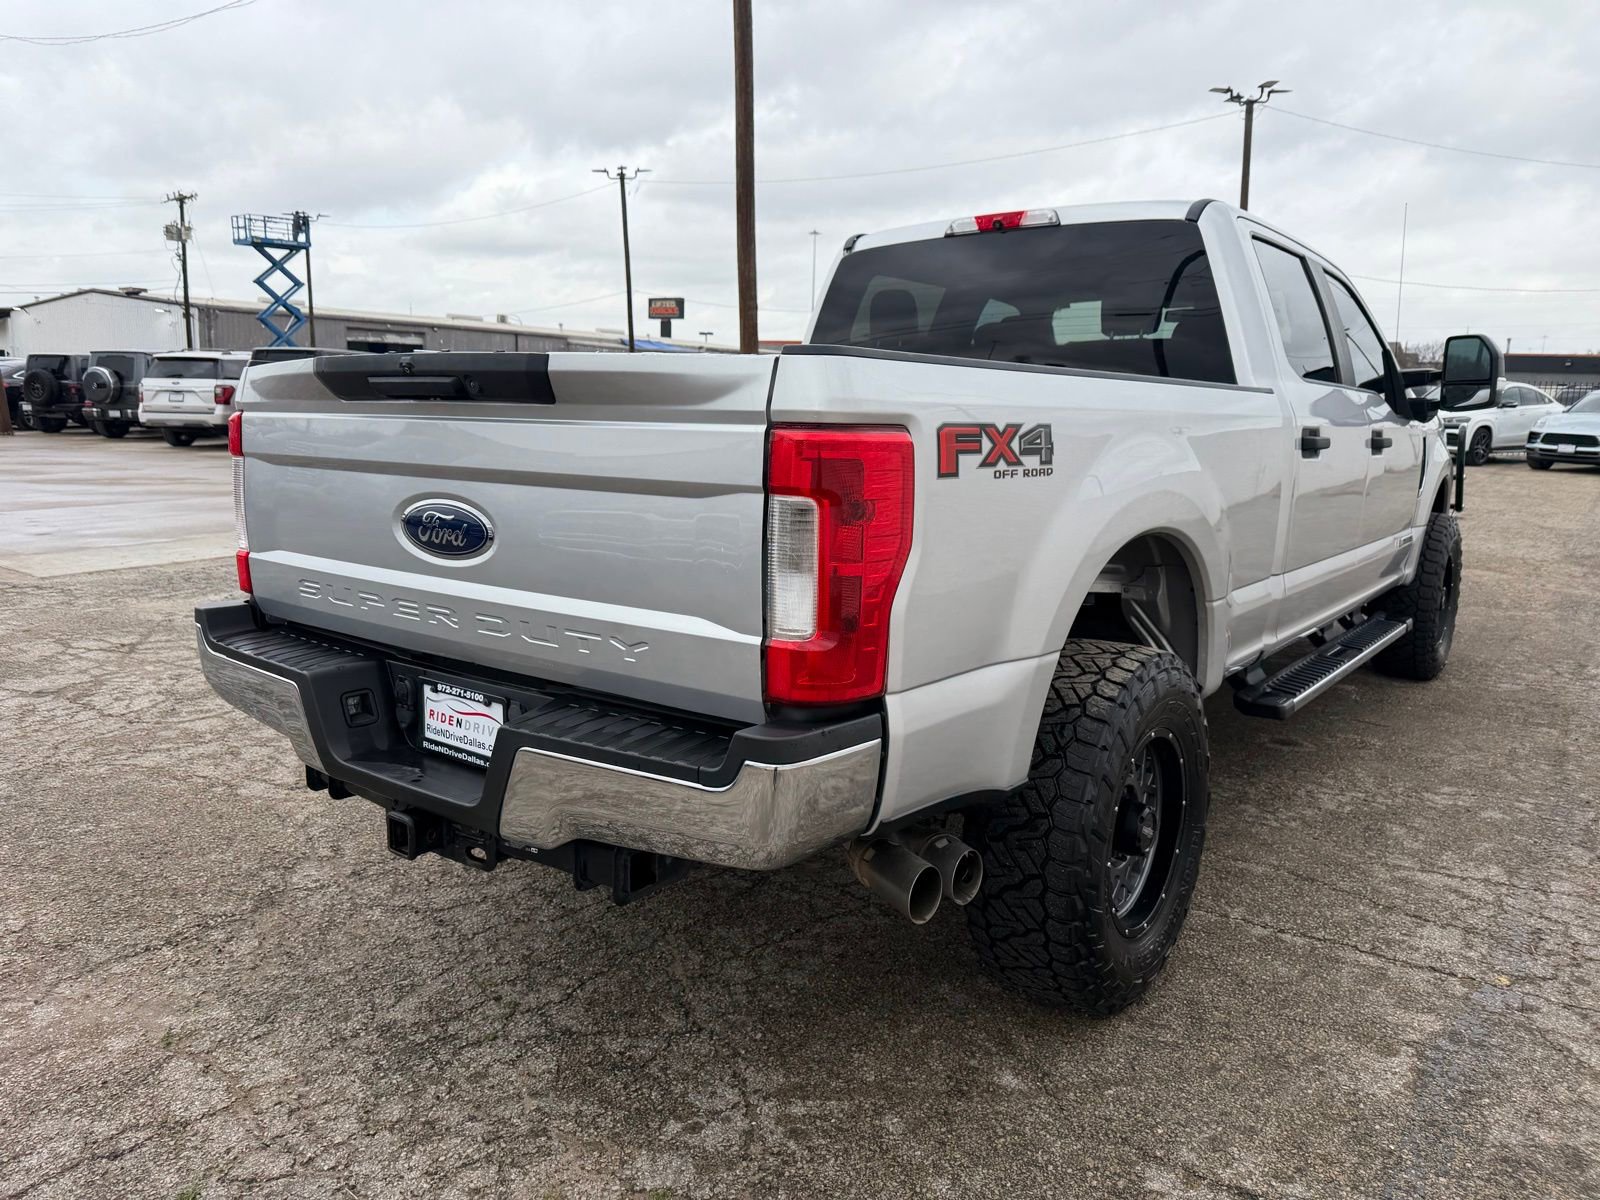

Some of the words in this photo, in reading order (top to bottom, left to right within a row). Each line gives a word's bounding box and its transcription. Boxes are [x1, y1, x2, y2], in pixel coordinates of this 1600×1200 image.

[937, 423, 1054, 478] FX4
[993, 469, 1018, 479] OFF
[1023, 467, 1053, 478] ROAD
[418, 511, 467, 546] Ford
[298, 579, 459, 628] SUPER
[475, 613, 649, 662] DUTY
[429, 709, 494, 737] RIDENDRIV
